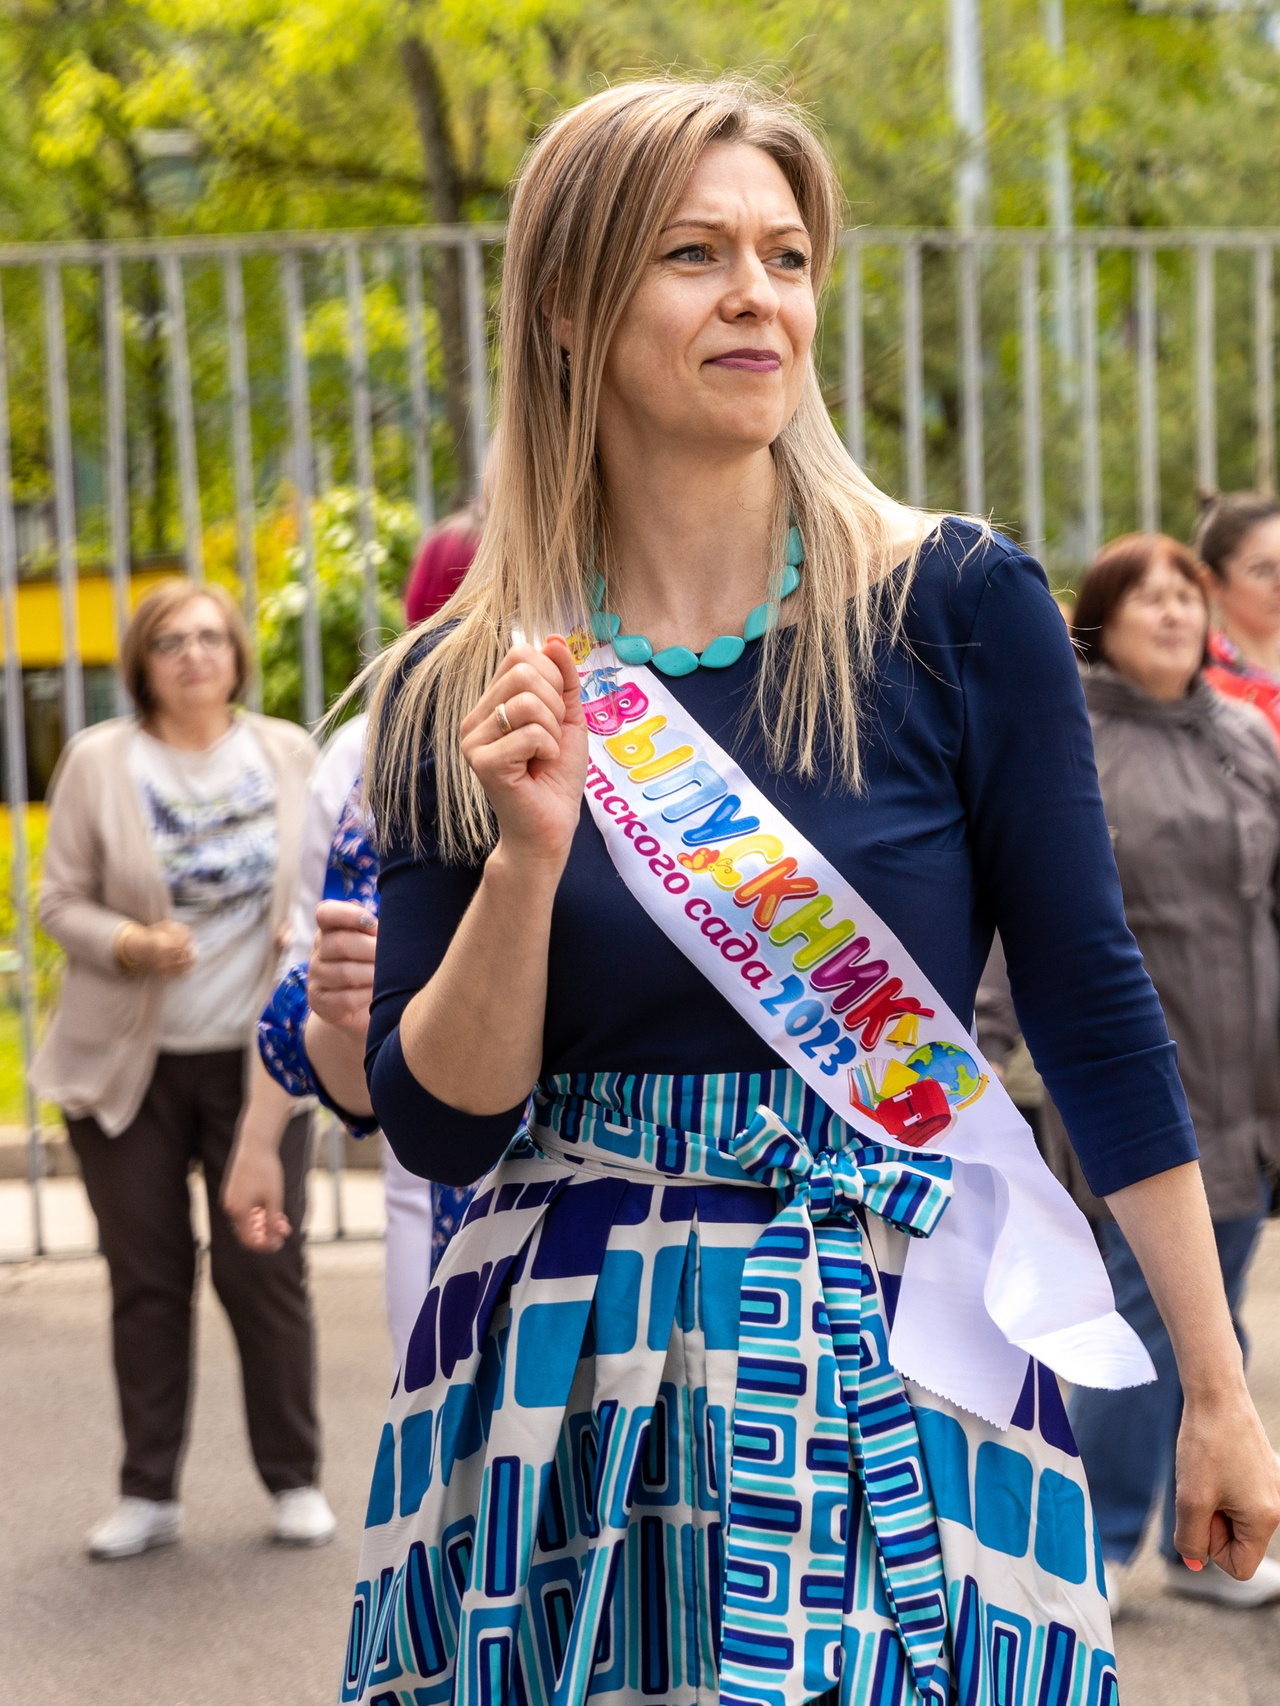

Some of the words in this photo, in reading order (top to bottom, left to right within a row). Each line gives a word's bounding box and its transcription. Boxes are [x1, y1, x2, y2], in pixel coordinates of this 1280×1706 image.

[583, 681, 921, 1052] ВЫПУСКНИК
[587, 753, 690, 894] тского
[684, 897, 773, 990] сада
[759, 973, 857, 1077] 2023
